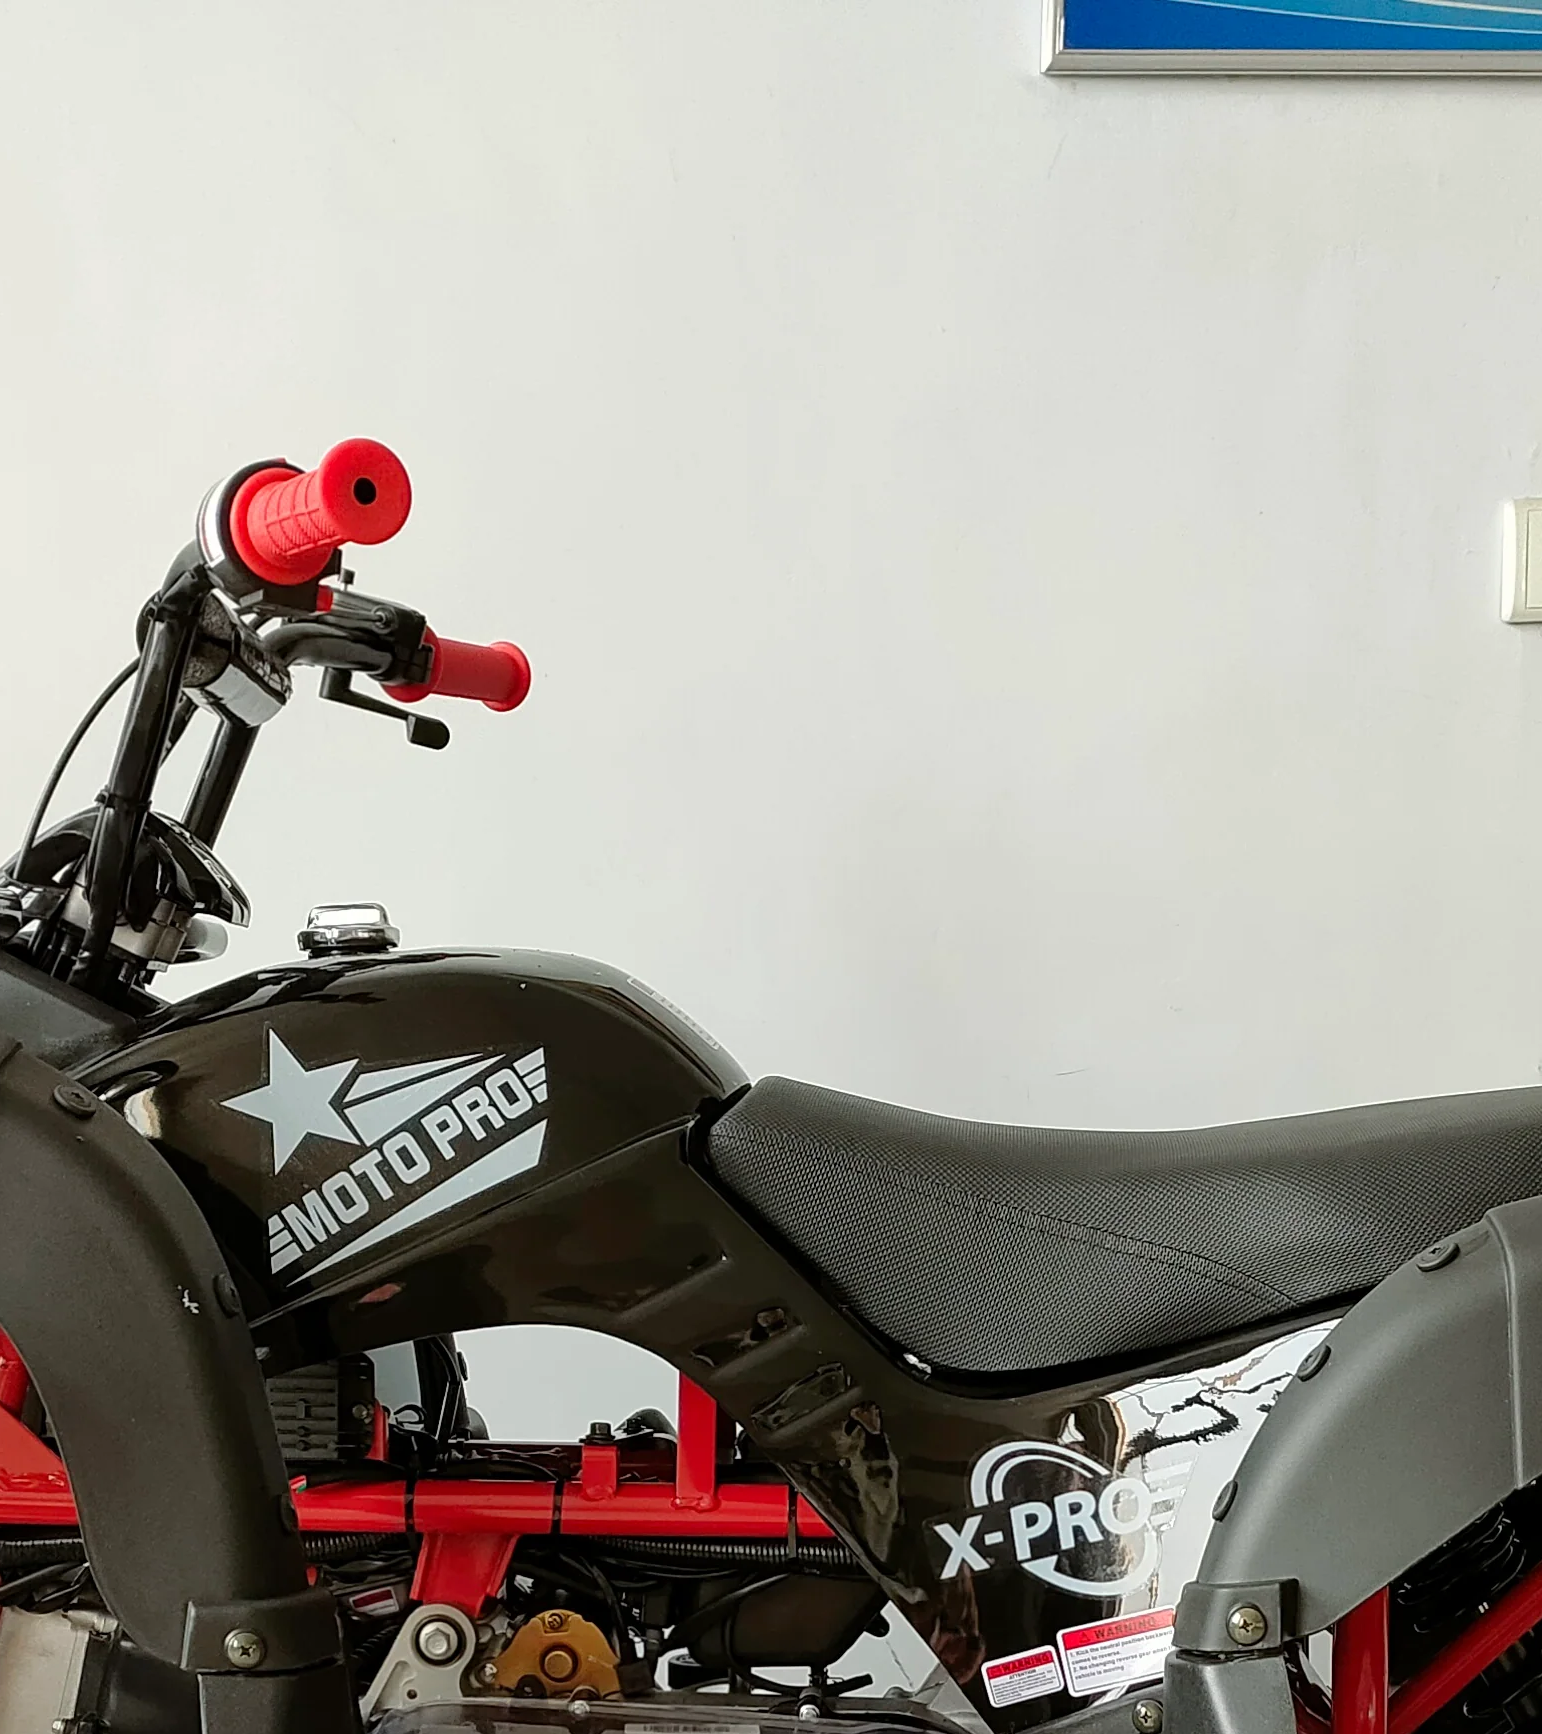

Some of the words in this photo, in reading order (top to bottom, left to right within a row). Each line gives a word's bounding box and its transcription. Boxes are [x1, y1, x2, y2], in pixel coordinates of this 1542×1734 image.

[281, 1130, 431, 1252] MOTO
[420, 1068, 533, 1160] PRO
[933, 1477, 1152, 1579] X-PRO
[1094, 1617, 1157, 1640] WARNING
[1002, 1654, 1051, 1674] WARNING
[1088, 1658, 1116, 1671] changing
